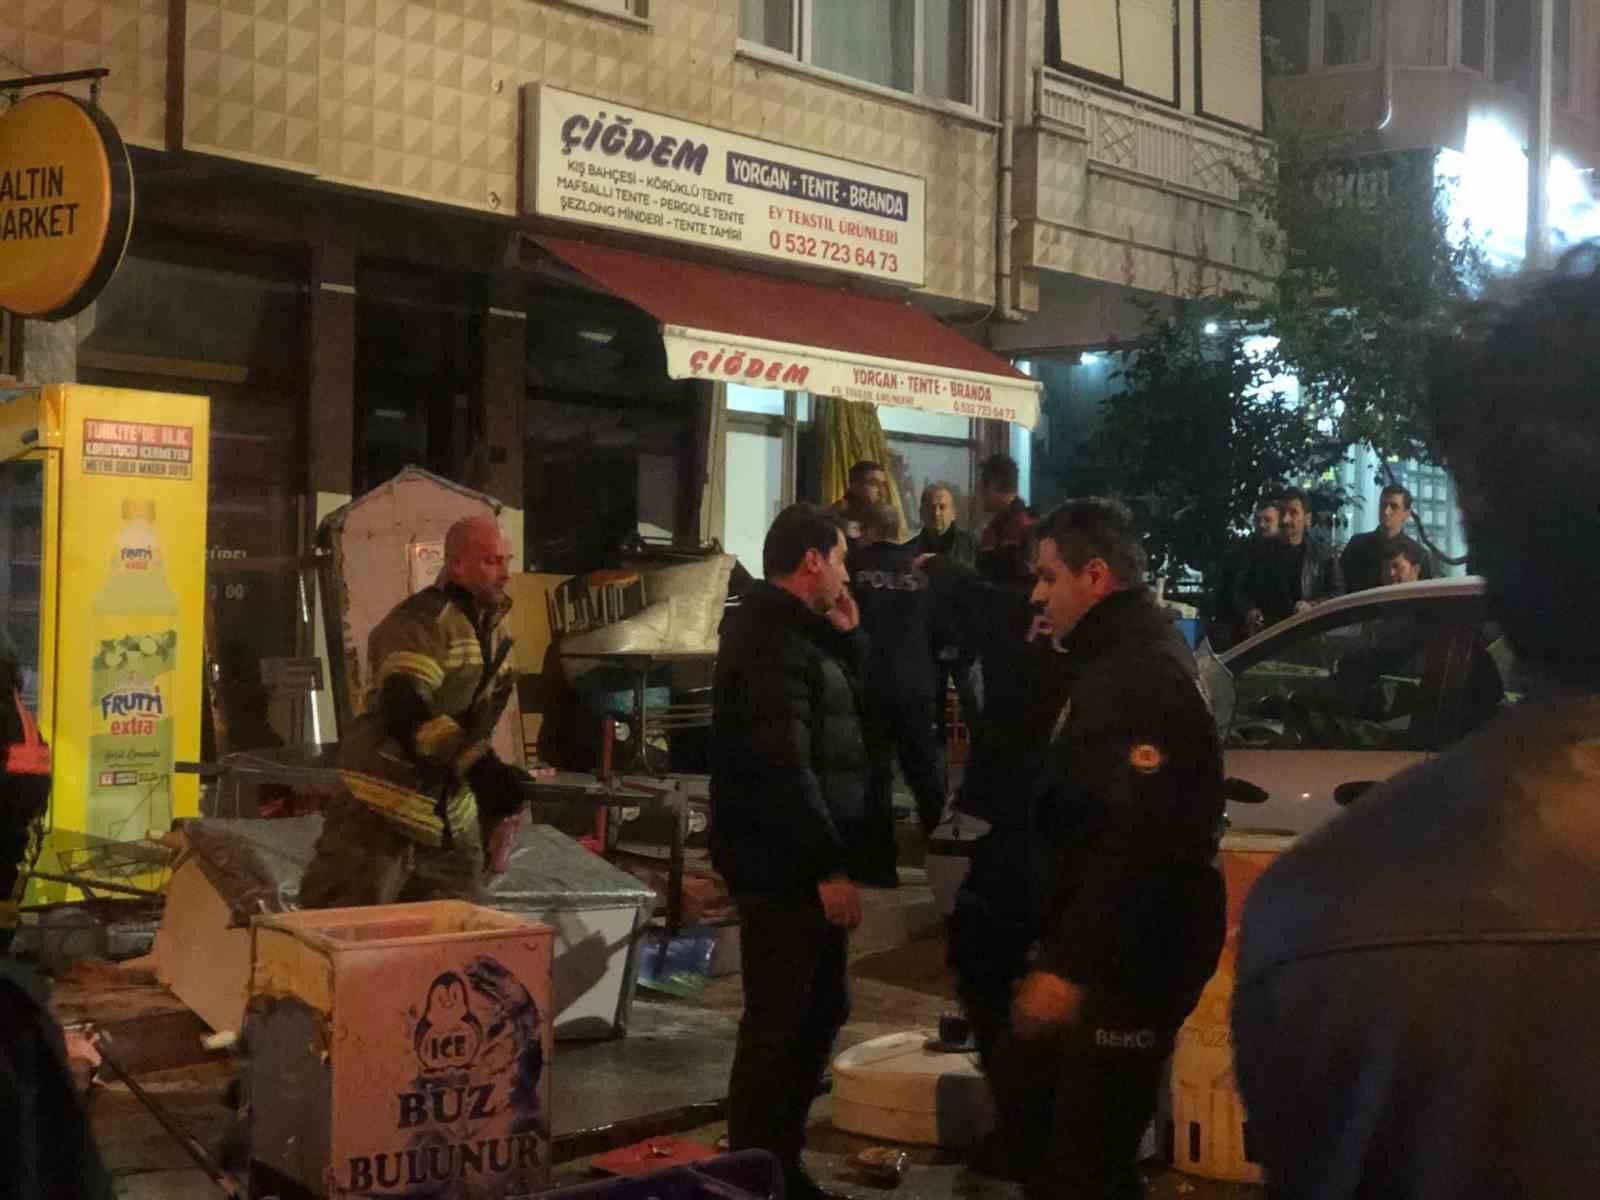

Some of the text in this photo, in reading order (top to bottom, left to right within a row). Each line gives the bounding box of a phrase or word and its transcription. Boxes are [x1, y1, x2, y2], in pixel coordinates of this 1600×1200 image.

[561, 111, 709, 176] ÇİĞDEM
[1, 165, 64, 200] ALTIN
[567, 159, 586, 176] KIŞ
[588, 163, 637, 185] BAHÇESİ
[702, 188, 734, 205] TENTE
[732, 157, 904, 217] YORGAN TENTE BRANDA
[0, 203, 79, 240] ARKET
[560, 195, 742, 241] ŞEZLONG MİNDERİ TENTE TAMİRİ
[615, 188, 650, 206] TENTE
[660, 198, 711, 218] PERGOLE
[712, 207, 745, 225] TENTE
[768, 204, 783, 220] EV
[769, 229, 898, 273] 0 532 723 64 73
[689, 348, 810, 385] ÇİĞDEM
[852, 367, 897, 390] YORGAN
[907, 375, 940, 396] TENTE
[950, 380, 992, 401] BRANDA
[111, 717, 155, 736] extra
[431, 1035, 466, 1060] ICE
[398, 1083, 496, 1129] BUZ
[350, 1134, 547, 1191] BULUNUR
